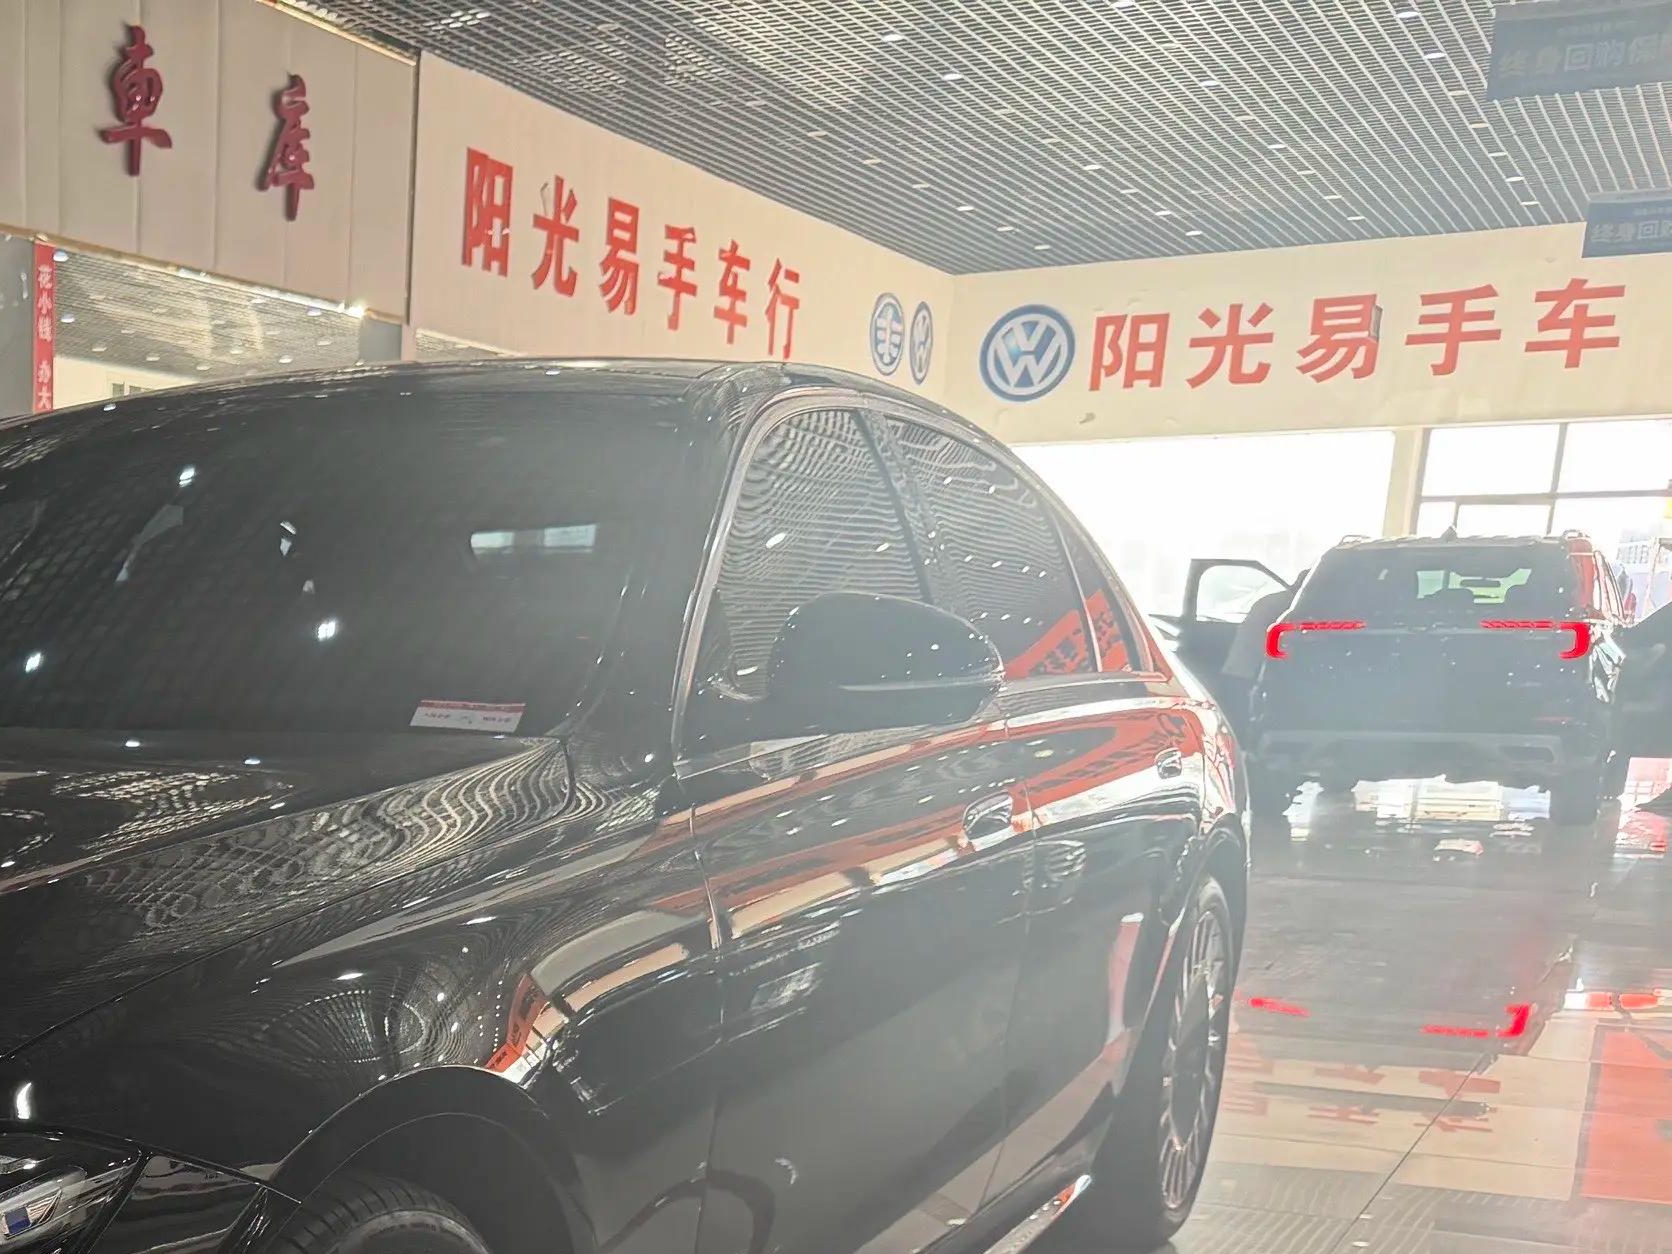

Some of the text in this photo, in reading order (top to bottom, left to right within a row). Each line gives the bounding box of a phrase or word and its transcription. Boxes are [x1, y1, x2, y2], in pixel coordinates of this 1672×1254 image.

[37, 264, 53, 342] 花小钱
[461, 146, 800, 360] 阳光易手车行
[1088, 277, 1626, 393] 阳光易手车
